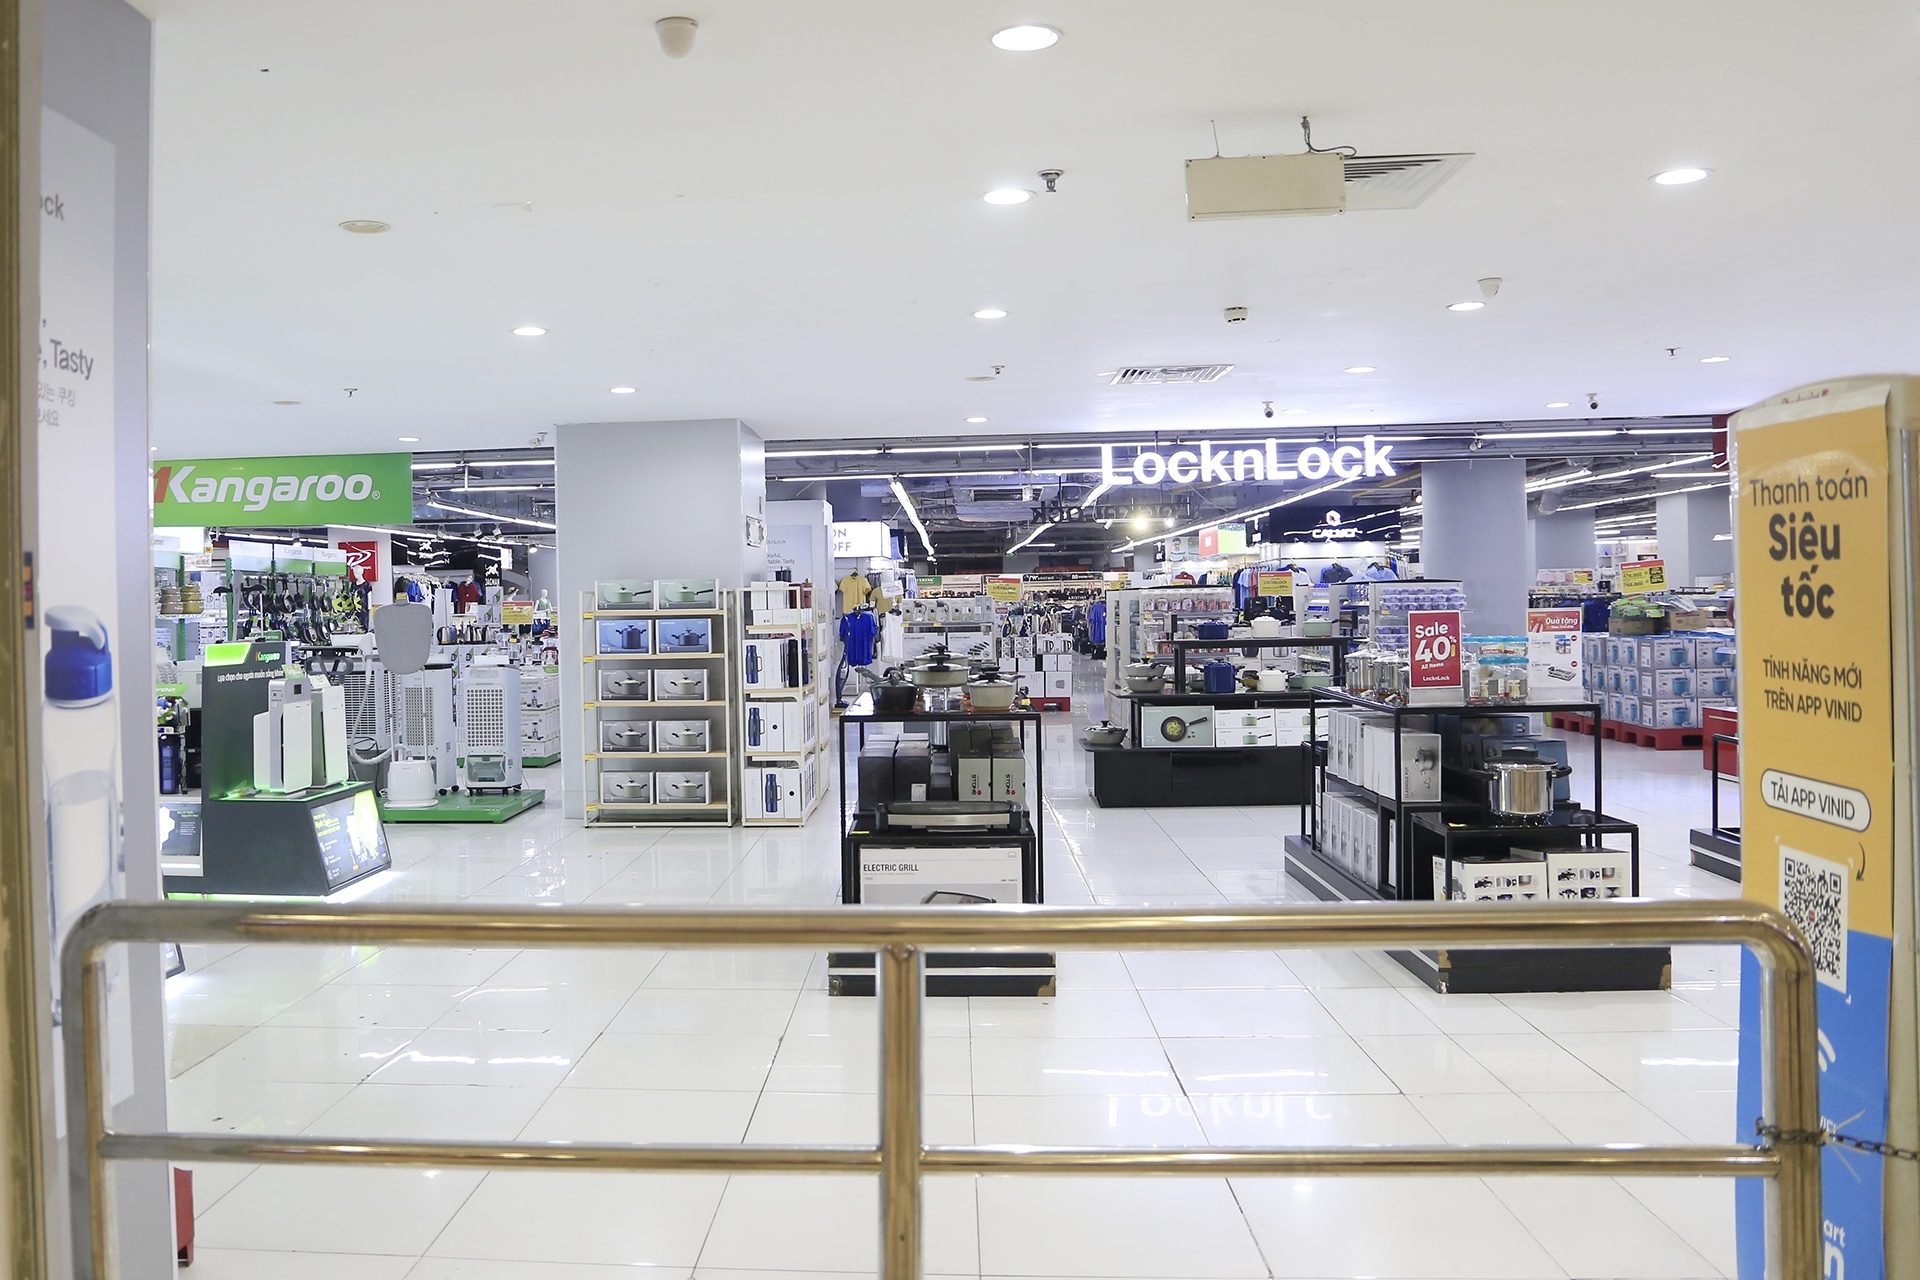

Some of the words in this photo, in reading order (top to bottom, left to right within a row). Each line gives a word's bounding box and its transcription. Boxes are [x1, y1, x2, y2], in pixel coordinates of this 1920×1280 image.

[50, 338, 93, 380] Tasty
[1101, 435, 1397, 485] LocknLock
[154, 466, 373, 512] Kangaroo
[1749, 474, 1810, 507] Thanh
[1815, 468, 1868, 501] toán
[1769, 511, 1841, 561] Siêu
[1781, 564, 1835, 619] tốc
[1414, 621, 1449, 639] Sale
[1545, 617, 1559, 625] Quà
[1414, 635, 1458, 663] 40%
[1422, 674, 1450, 682] LocknLock
[1763, 654, 1790, 681] TÍNH
[1792, 658, 1831, 685] NĂNG
[1834, 662, 1862, 690] MỚI
[1764, 686, 1794, 712] TRÊN
[1796, 694, 1822, 716] APP
[1824, 697, 1862, 723] VINID
[1771, 777, 1789, 803] TẢI
[1791, 787, 1816, 810] APP
[1818, 793, 1855, 821] VINID
[863, 864, 897, 872] ELECTRIC
[898, 863, 919, 872] GRILL
